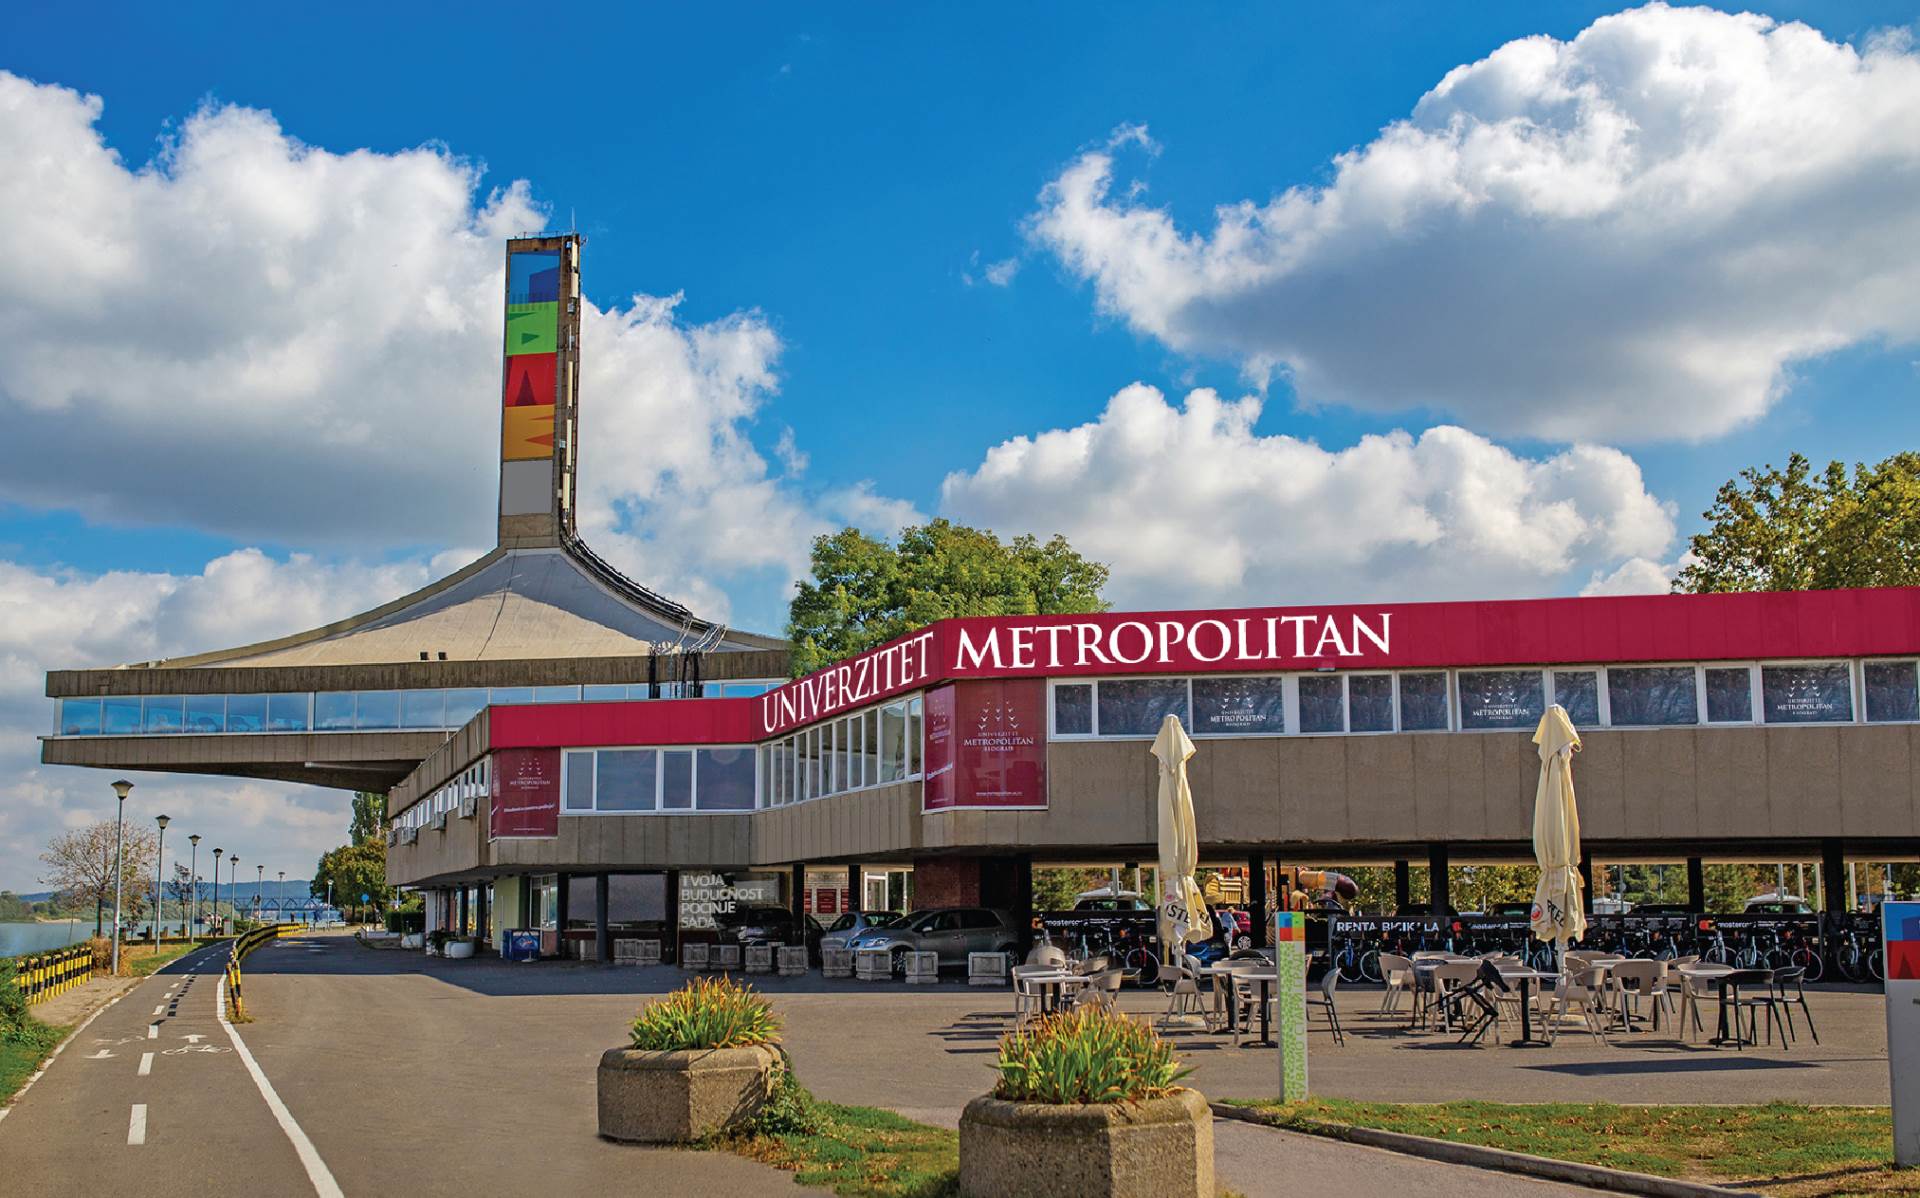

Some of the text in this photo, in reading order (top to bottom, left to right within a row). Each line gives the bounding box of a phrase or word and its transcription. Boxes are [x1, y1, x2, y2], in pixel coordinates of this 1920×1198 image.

[763, 613, 1393, 733] UNIVERZITET METROPOLITAN
[963, 737, 1034, 746] METROPOLITAN
[681, 874, 725, 887] TVOJA
[681, 917, 718, 929] SADA
[1336, 922, 1377, 932] RENTA
